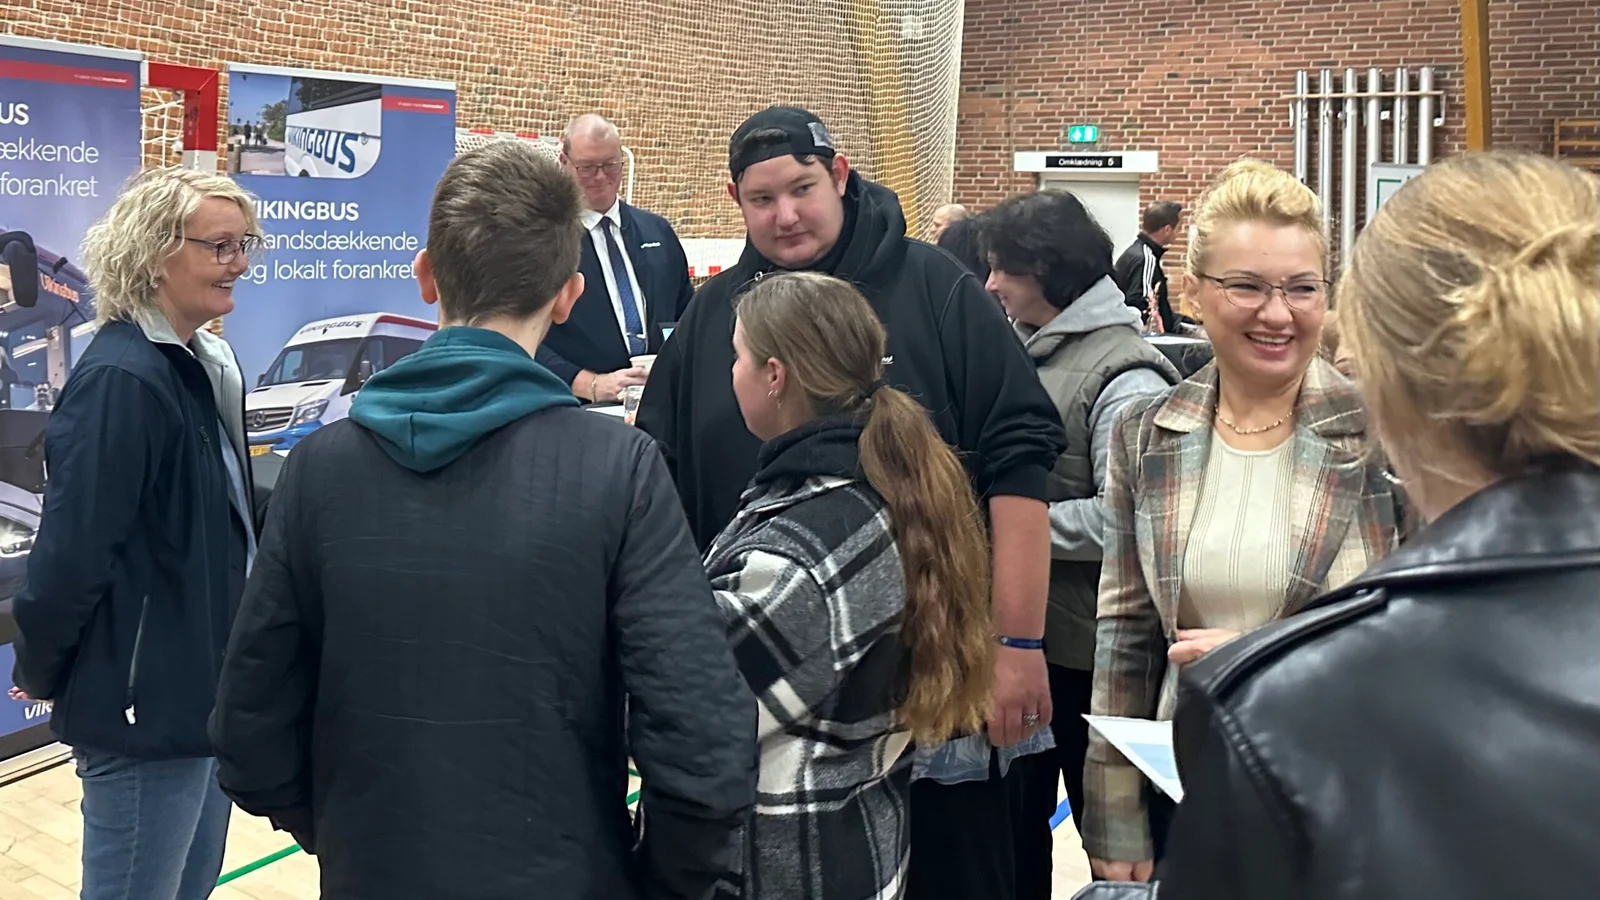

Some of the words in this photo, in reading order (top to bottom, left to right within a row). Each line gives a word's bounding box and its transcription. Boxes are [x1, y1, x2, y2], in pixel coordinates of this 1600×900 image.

[1058, 157, 1103, 167] Omklædning
[1, 171, 99, 197] forankret
[252, 200, 359, 221] IKINGBUS
[263, 229, 418, 251] andsdækkende
[239, 264, 267, 285] og
[274, 259, 327, 280] lokalt
[333, 259, 418, 280] forankret
